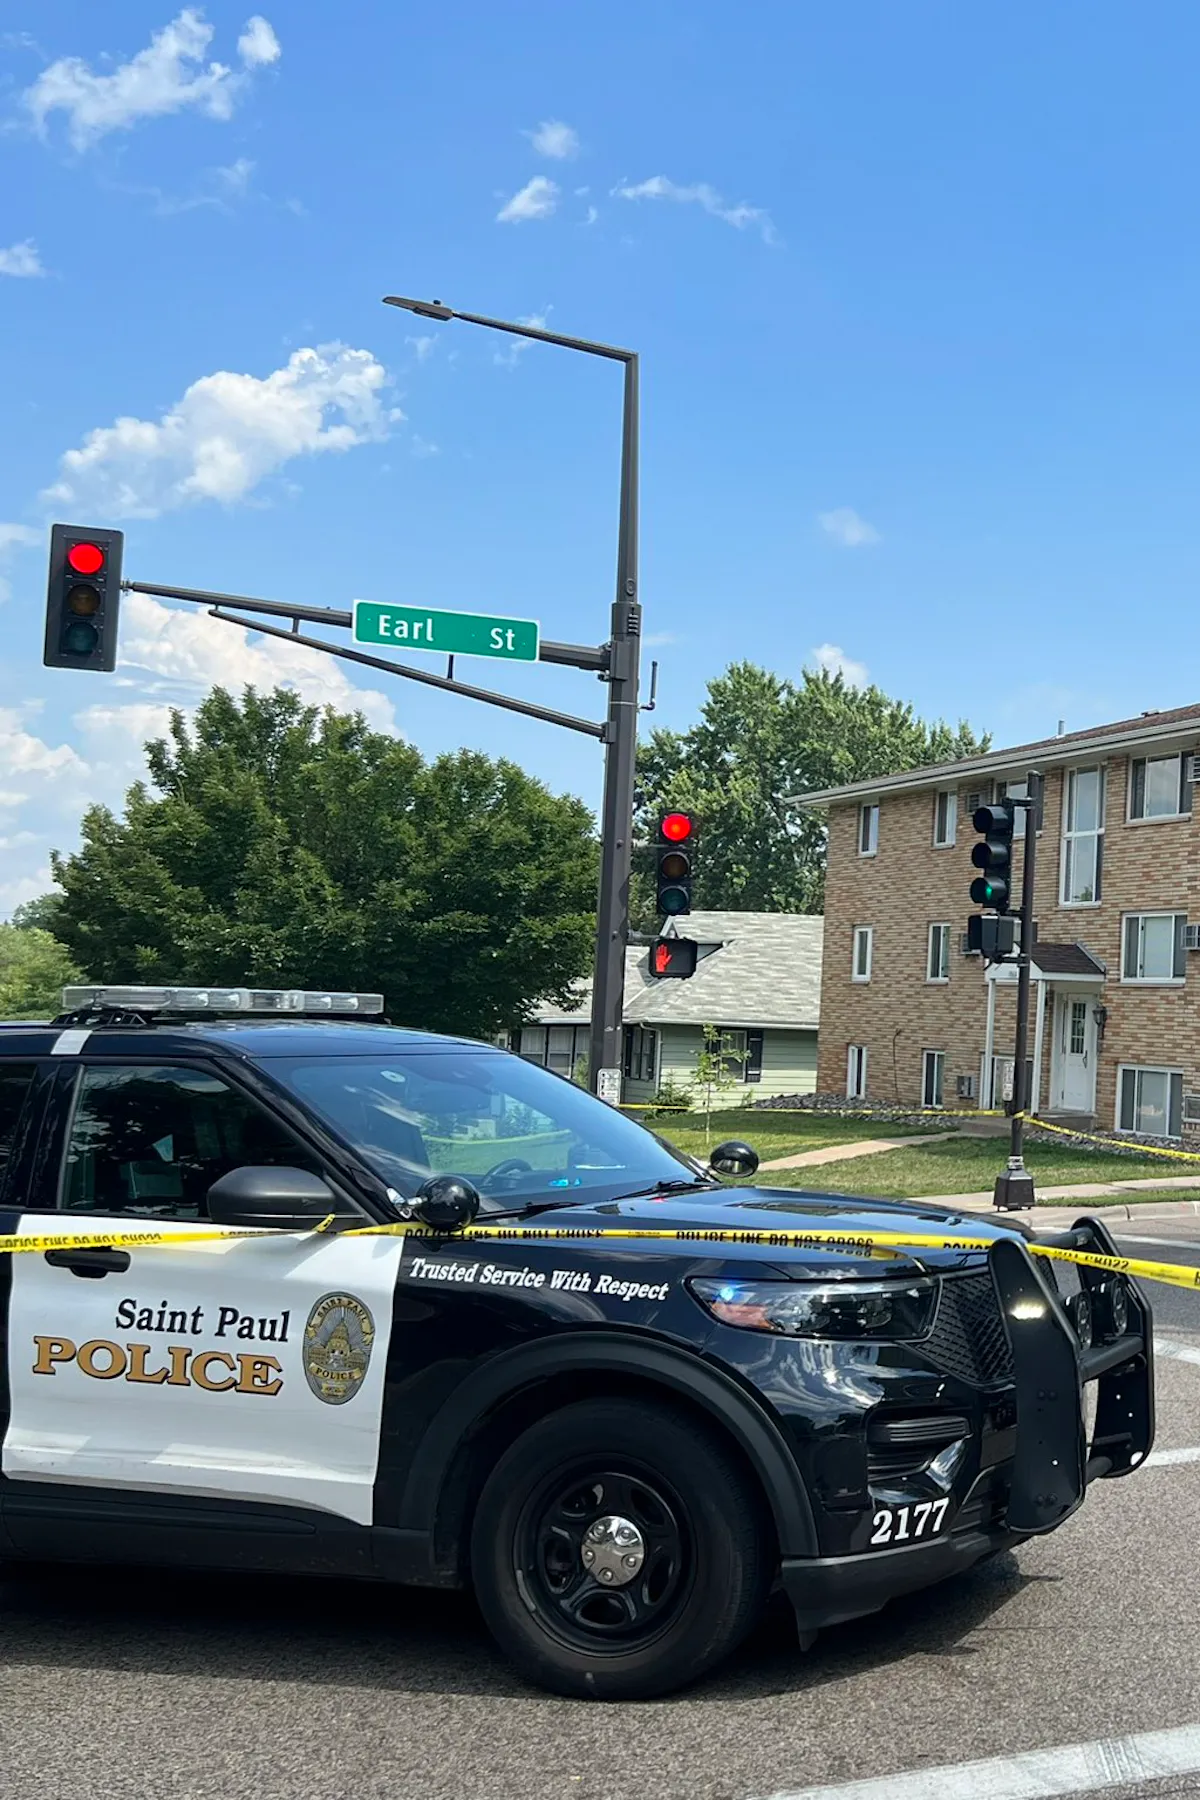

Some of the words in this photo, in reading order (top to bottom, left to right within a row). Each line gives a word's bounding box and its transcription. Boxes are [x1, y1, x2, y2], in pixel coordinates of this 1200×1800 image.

[378, 614, 434, 642] Earl
[489, 627, 515, 651] St
[409, 1257, 479, 1283] Trusted
[479, 1264, 546, 1288] Service
[549, 1270, 593, 1293] With
[593, 1274, 669, 1301] Respect
[116, 1298, 204, 1335] Saint
[214, 1306, 291, 1343] Paul
[32, 1335, 284, 1397] POLICE
[316, 1367, 356, 1380] POLICE
[870, 1497, 949, 1545] 2177
